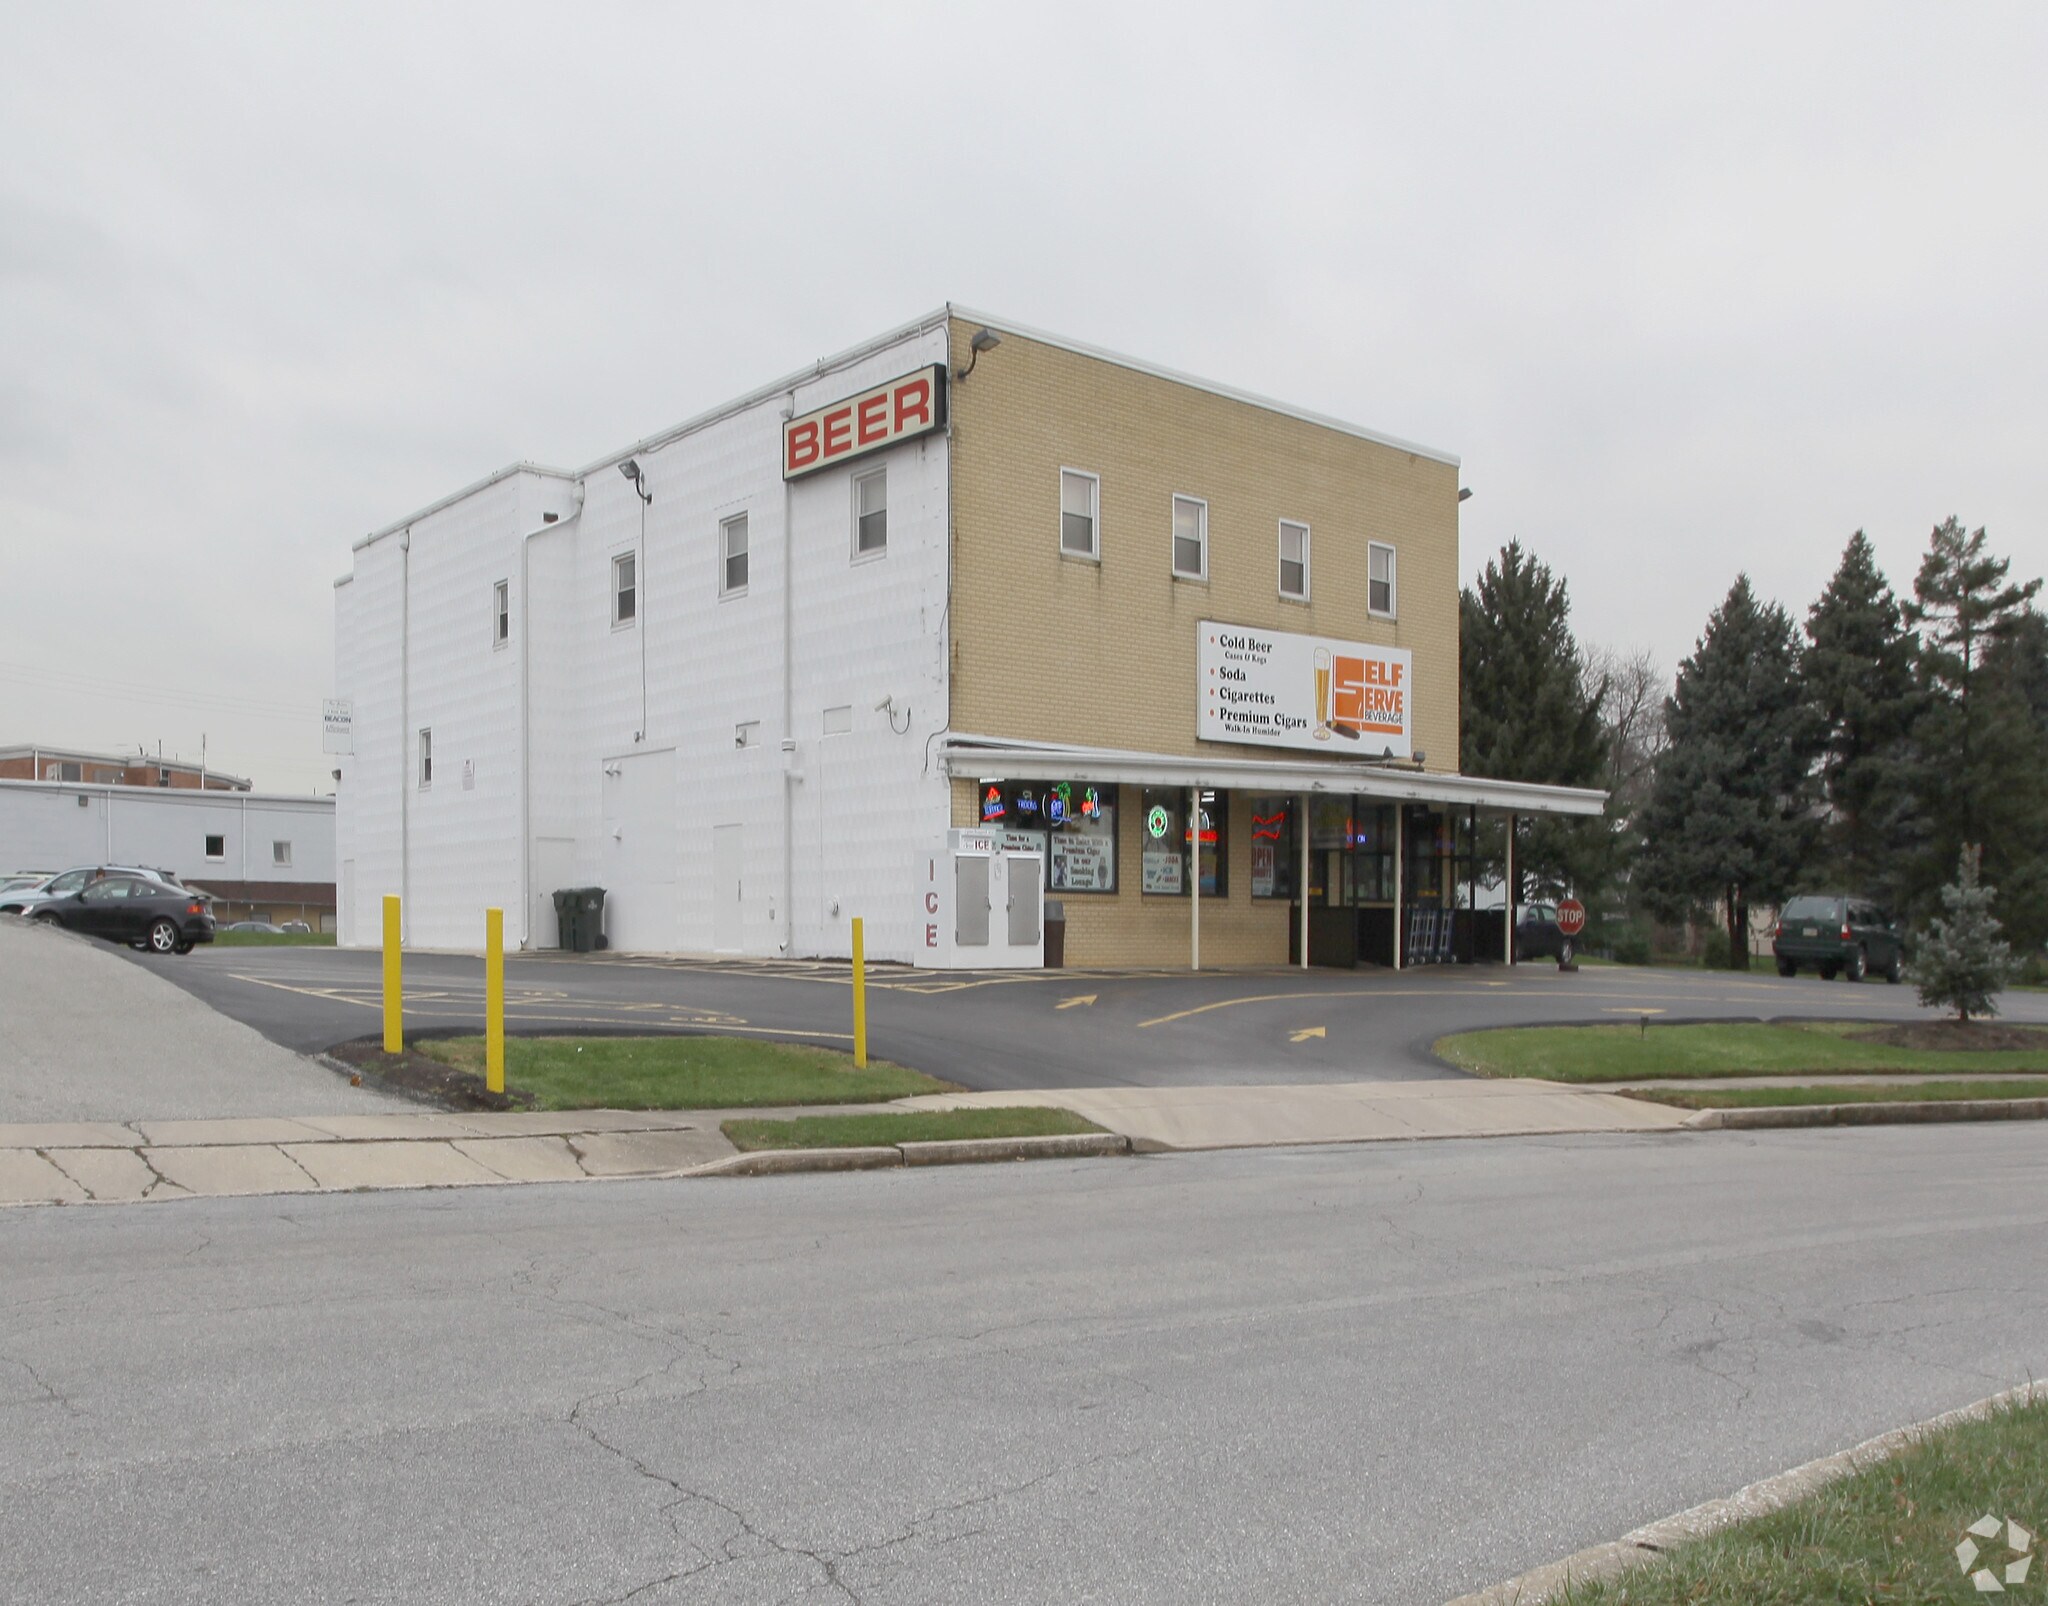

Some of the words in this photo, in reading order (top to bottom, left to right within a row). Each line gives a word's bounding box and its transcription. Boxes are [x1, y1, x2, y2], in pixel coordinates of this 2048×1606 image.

[788, 378, 930, 471] BEER
[1219, 634, 1245, 650] Cold
[1248, 638, 1273, 653] Beer
[1219, 666, 1246, 682] Soda
[1219, 686, 1275, 704] Cigarettes
[1219, 707, 1270, 725] Premium
[1274, 713, 1307, 730] Cigars
[1364, 710, 1403, 724] BEVERAGE
[975, 840, 989, 850] ICE
[925, 858, 939, 947] ICE
[1557, 908, 1583, 923] STOP
